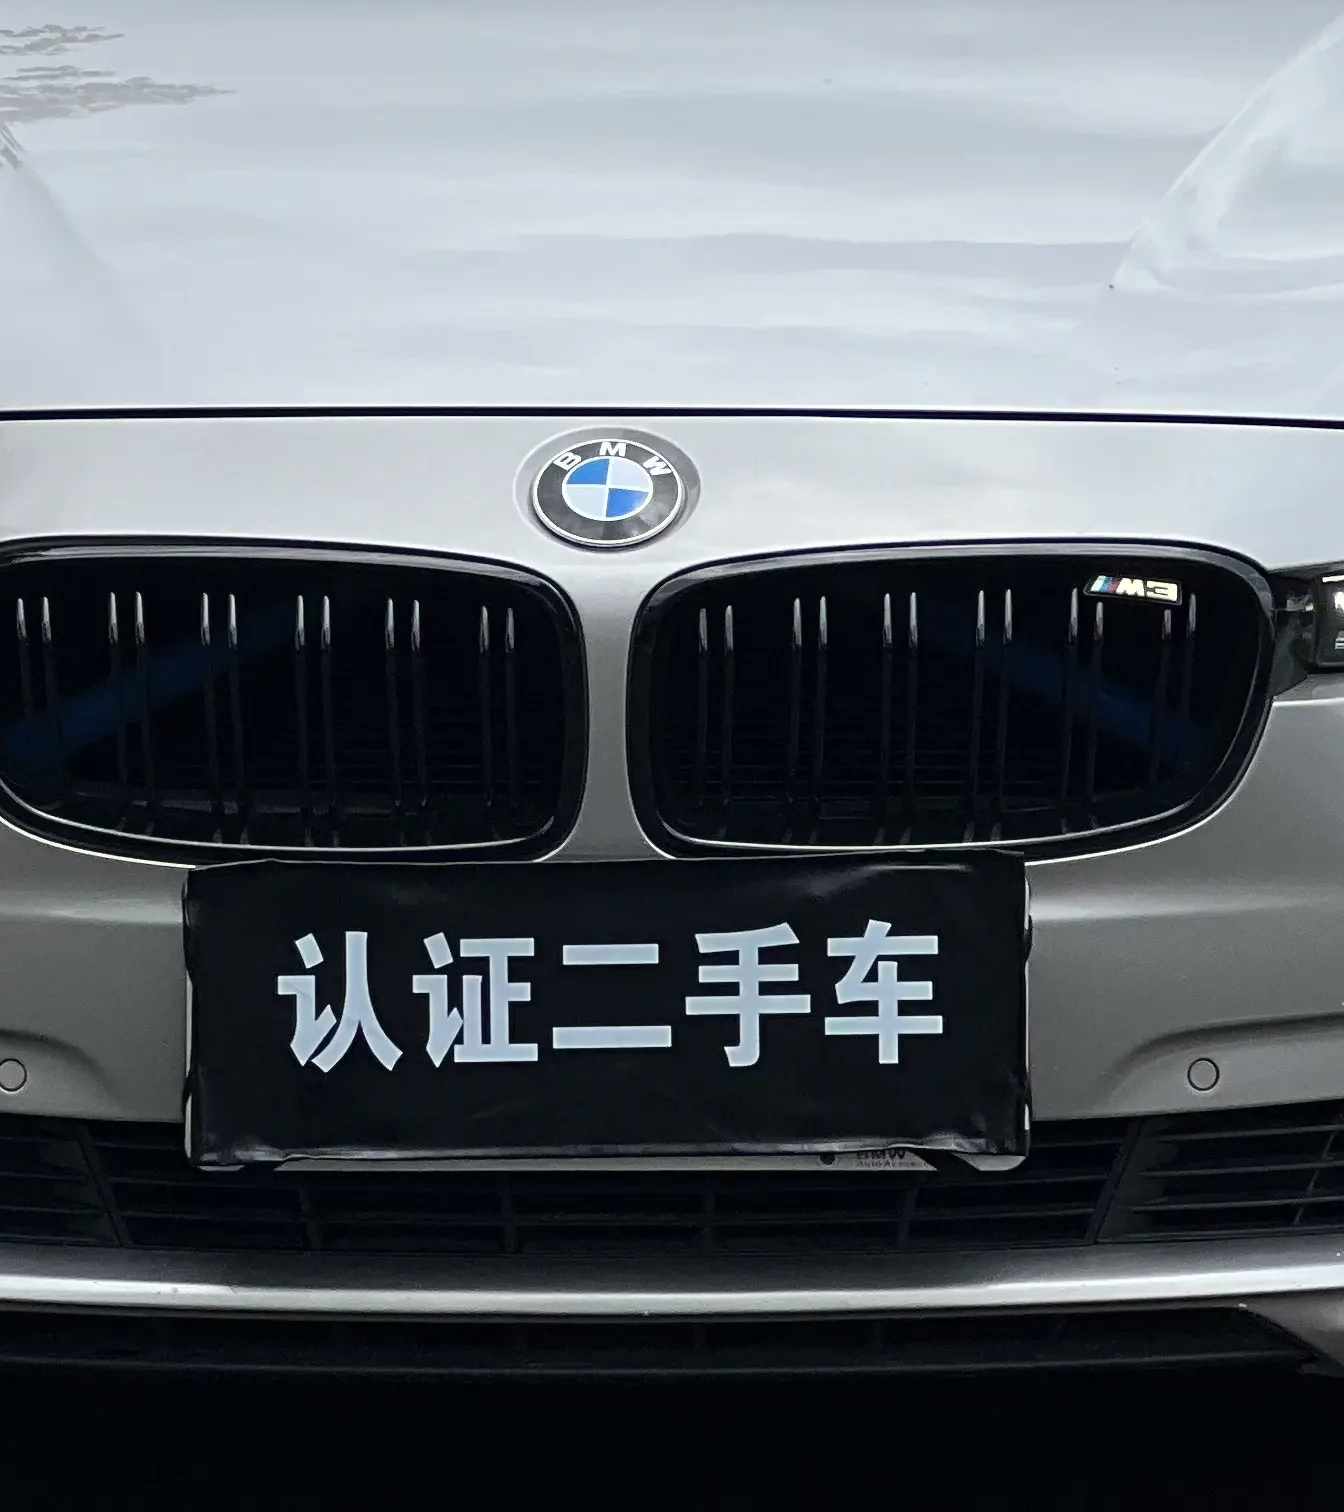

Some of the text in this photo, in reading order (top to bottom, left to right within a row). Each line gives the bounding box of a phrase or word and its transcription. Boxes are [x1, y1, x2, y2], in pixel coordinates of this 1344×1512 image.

[553, 441, 673, 476] BMW
[1115, 577, 1178, 602] M3
[277, 918, 943, 1073] 认证二手车
